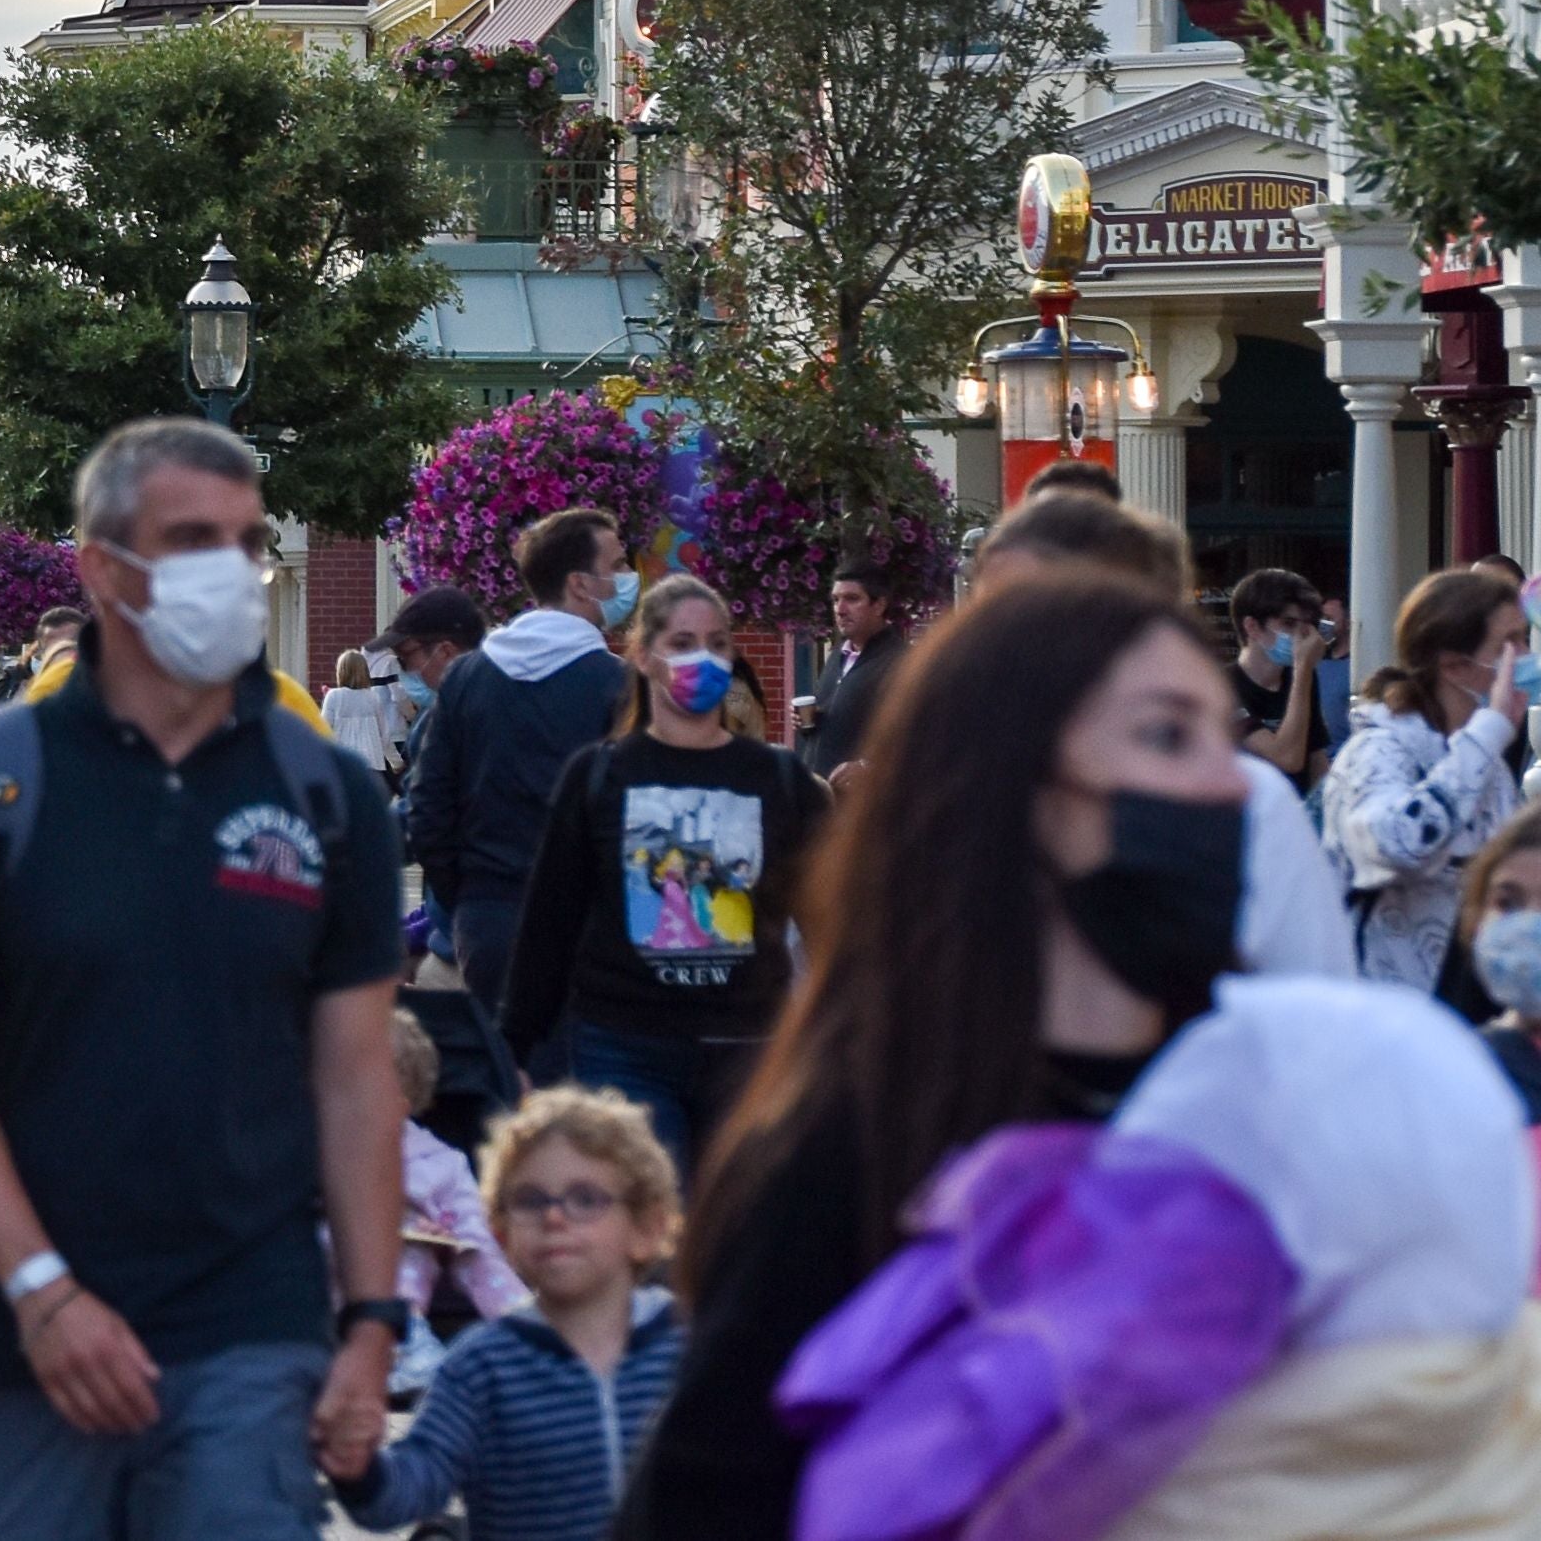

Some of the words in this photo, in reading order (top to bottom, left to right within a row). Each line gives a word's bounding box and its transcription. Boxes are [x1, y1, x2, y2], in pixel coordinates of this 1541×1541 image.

[1171, 181, 1247, 213] MARKET
[1251, 181, 1311, 210] HOUSE
[656, 965, 732, 986] CREW
